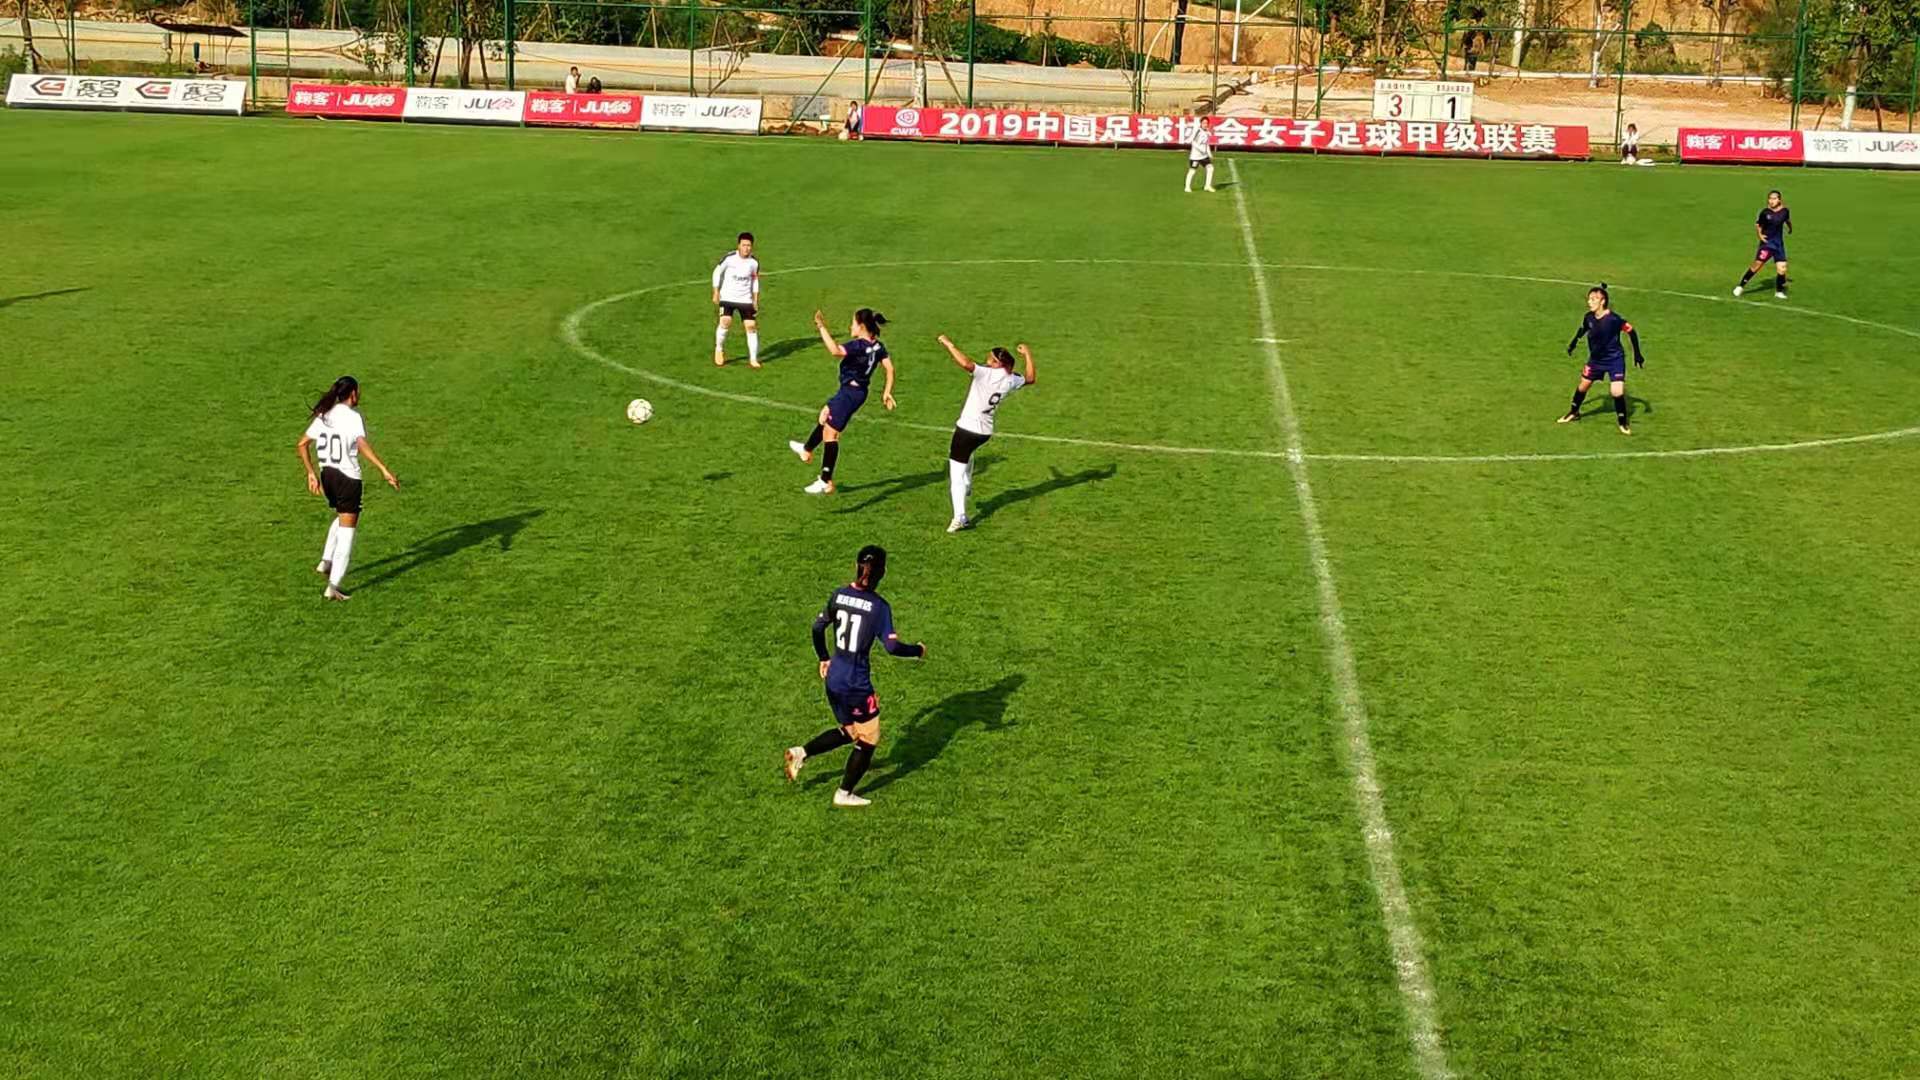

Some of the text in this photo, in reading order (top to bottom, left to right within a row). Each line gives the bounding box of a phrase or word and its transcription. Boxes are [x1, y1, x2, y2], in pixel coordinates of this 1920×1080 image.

[1389, 94, 1456, 119] 3 1
[940, 111, 1556, 154] 2019中国足球协会女子足球甲级联赛
[982, 392, 1001, 416] 9
[317, 433, 343, 464] 20
[836, 609, 862, 653] 21
